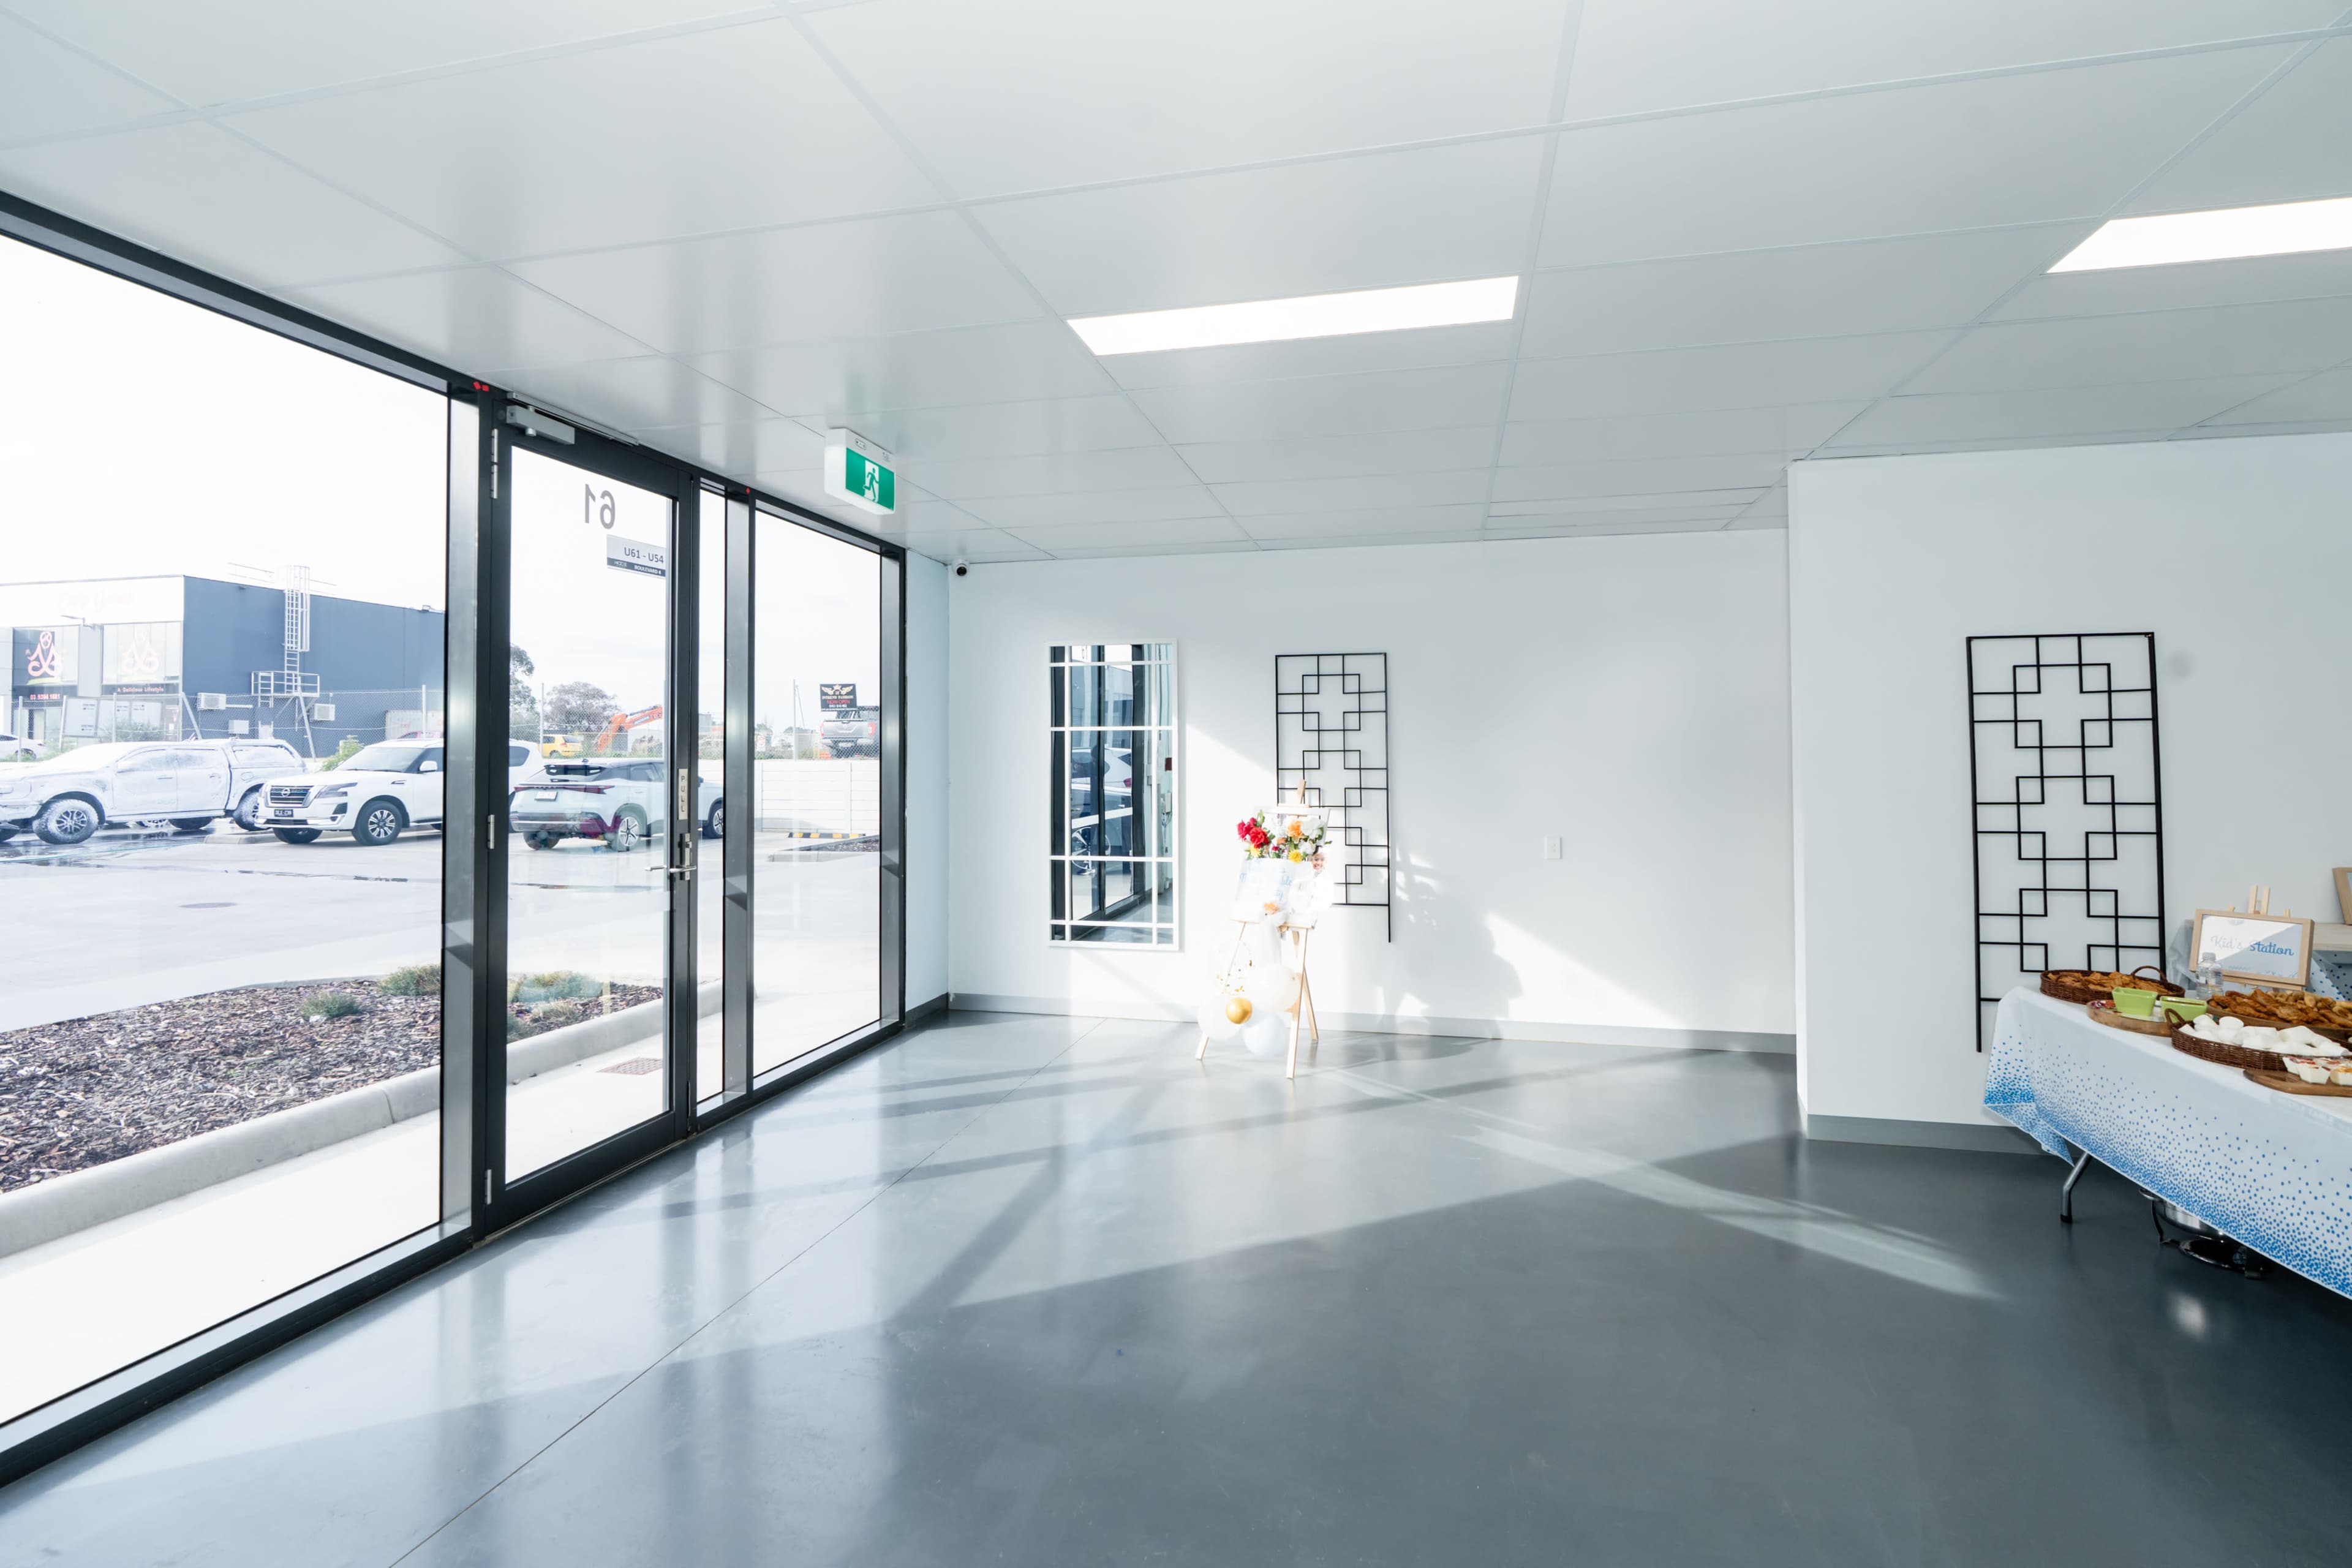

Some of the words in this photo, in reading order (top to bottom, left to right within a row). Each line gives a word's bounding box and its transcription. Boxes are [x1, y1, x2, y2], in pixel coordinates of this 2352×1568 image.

[624, 547, 641, 559] U61
[648, 552, 664, 564] U54
[634, 565, 658, 574] BOULEVARD
[2210, 935, 2244, 949] Kid's
[2249, 940, 2294, 956] Station
